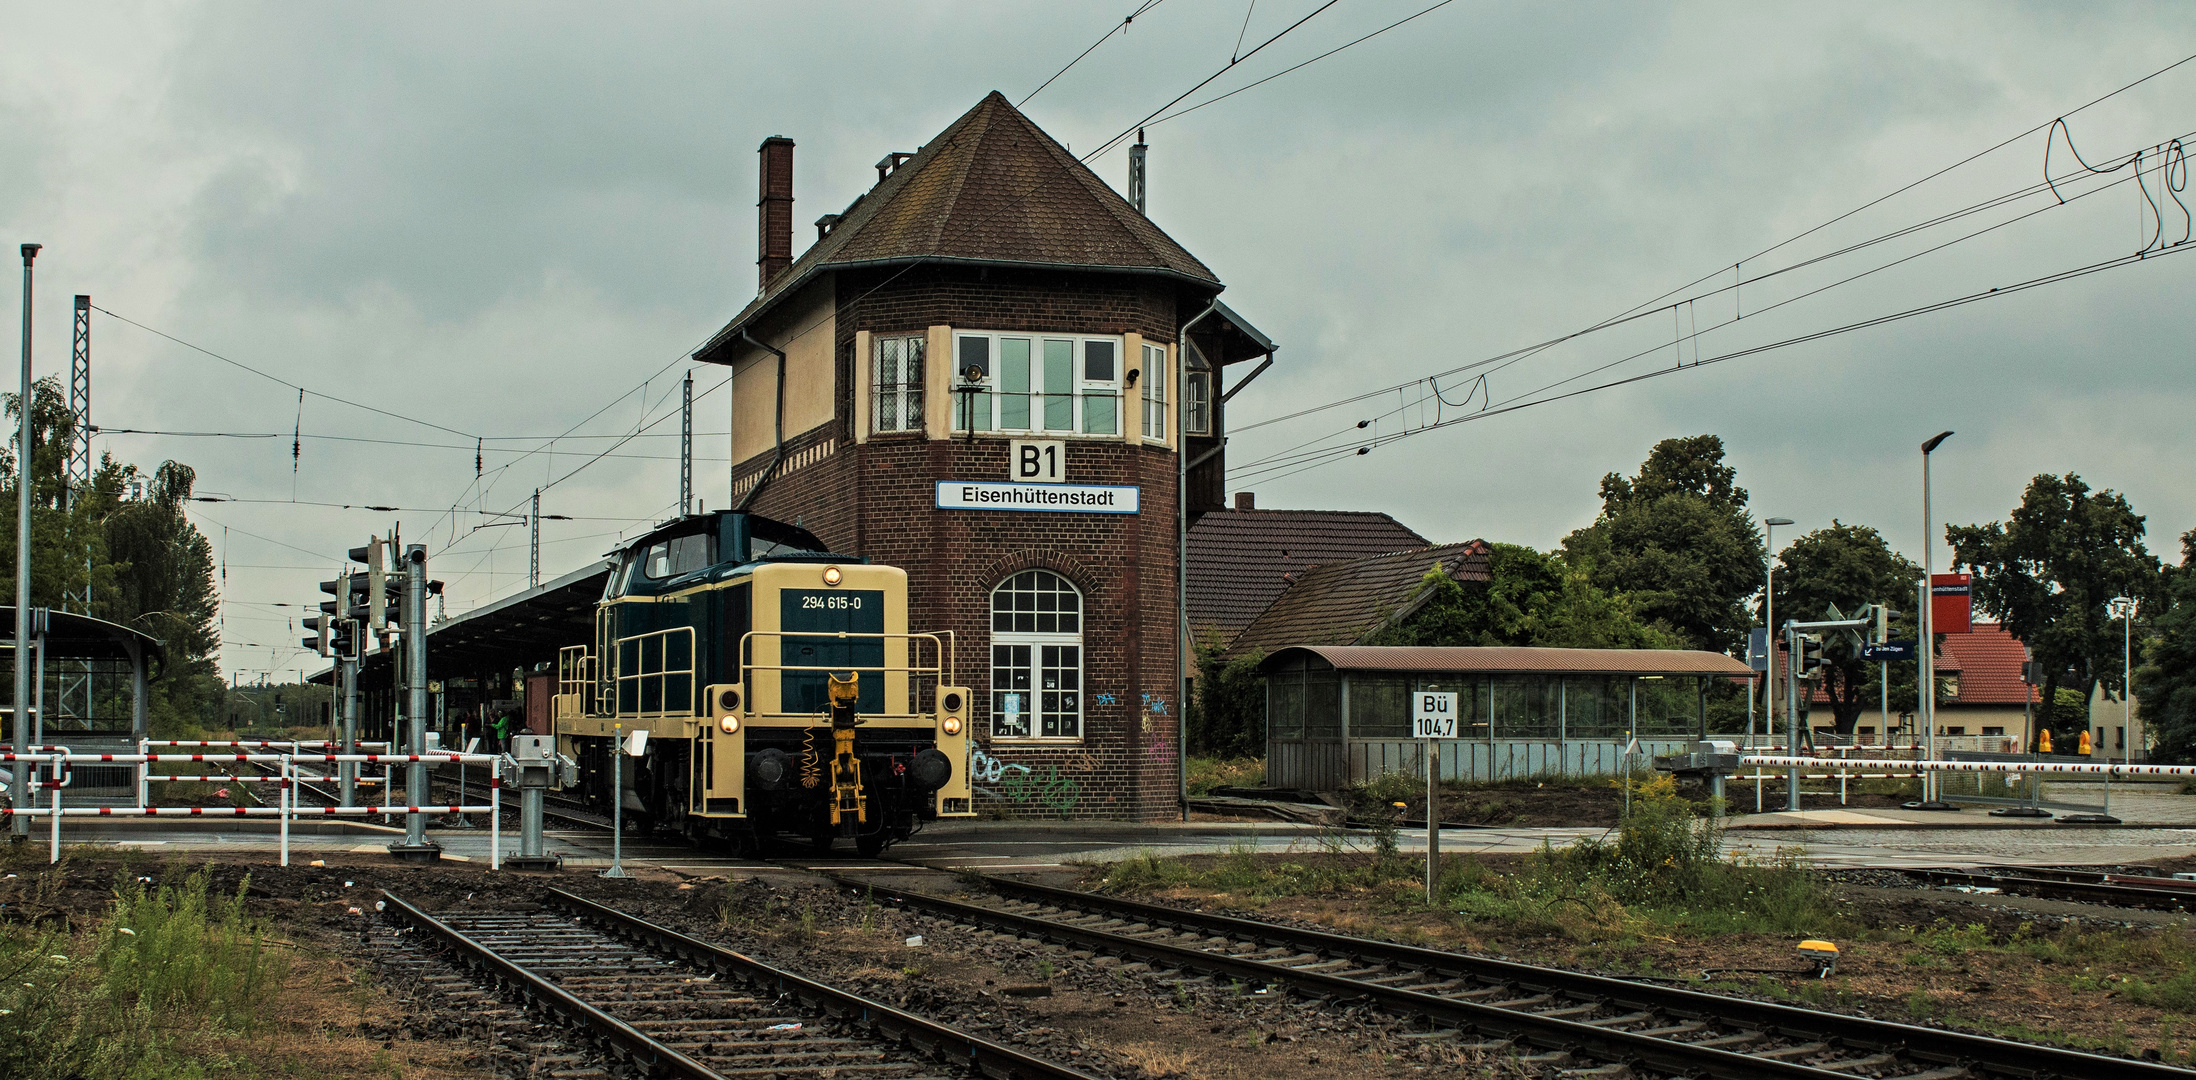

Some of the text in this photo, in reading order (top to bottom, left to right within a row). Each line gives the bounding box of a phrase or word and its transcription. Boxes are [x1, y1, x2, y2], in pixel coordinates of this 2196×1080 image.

[1020, 444, 1056, 478] B1
[962, 487, 1114, 506] Eisenhüttenstadt
[802, 596, 861, 609] 294 615-0
[1423, 695, 1448, 713] Bü
[1417, 718, 1454, 737] 104,7
